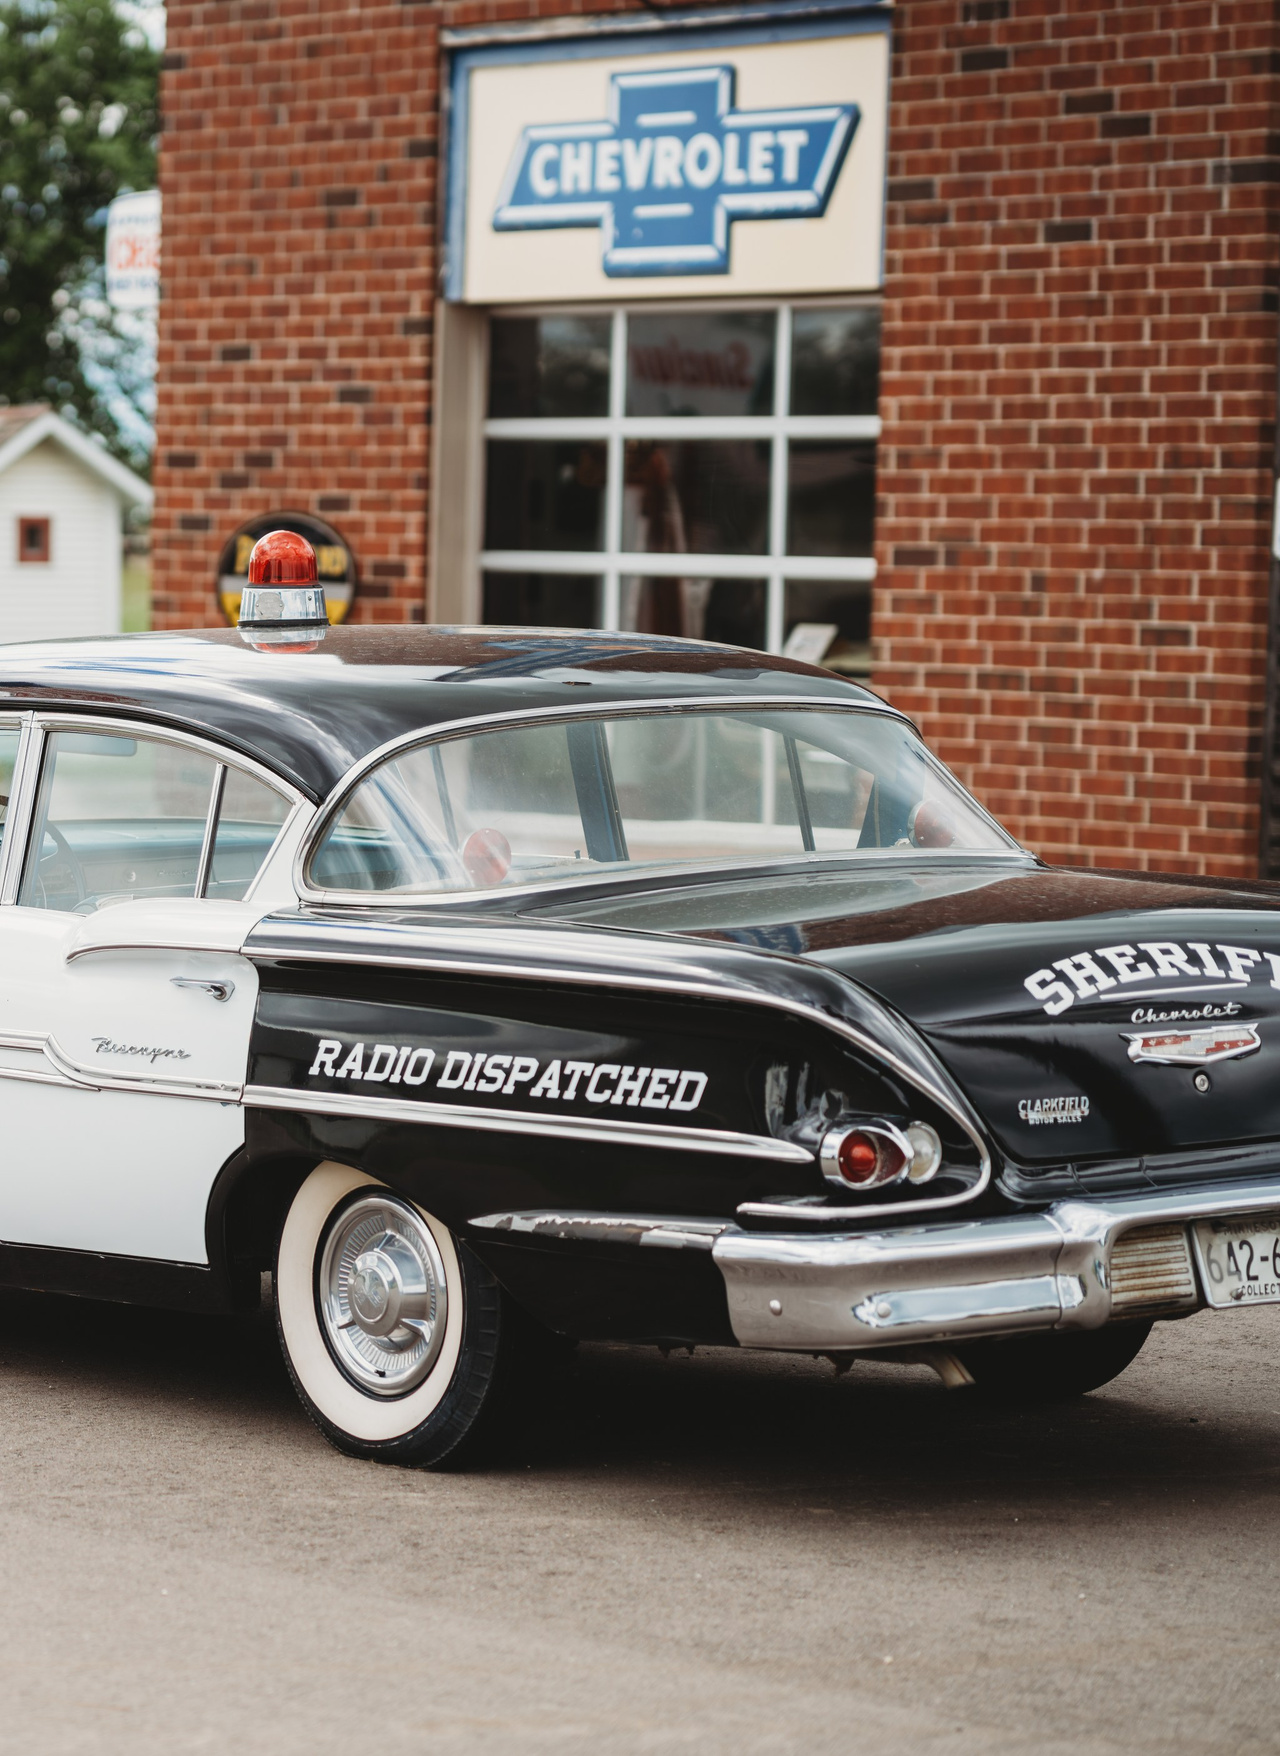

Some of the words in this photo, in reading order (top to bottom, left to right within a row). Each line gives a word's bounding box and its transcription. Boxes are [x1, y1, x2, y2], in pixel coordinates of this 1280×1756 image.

[529, 128, 809, 198] CHEVROLET
[1131, 1001, 1243, 1024] Chevrolet
[308, 1039, 437, 1085] RADIO
[436, 1051, 709, 1112] DISPATCHED
[1018, 1096, 1089, 1113] CLARKFIELD
[1028, 1115, 1054, 1125] MOTOR
[1057, 1114, 1082, 1123] SALES
[1223, 1220, 1280, 1236] MINNESO
